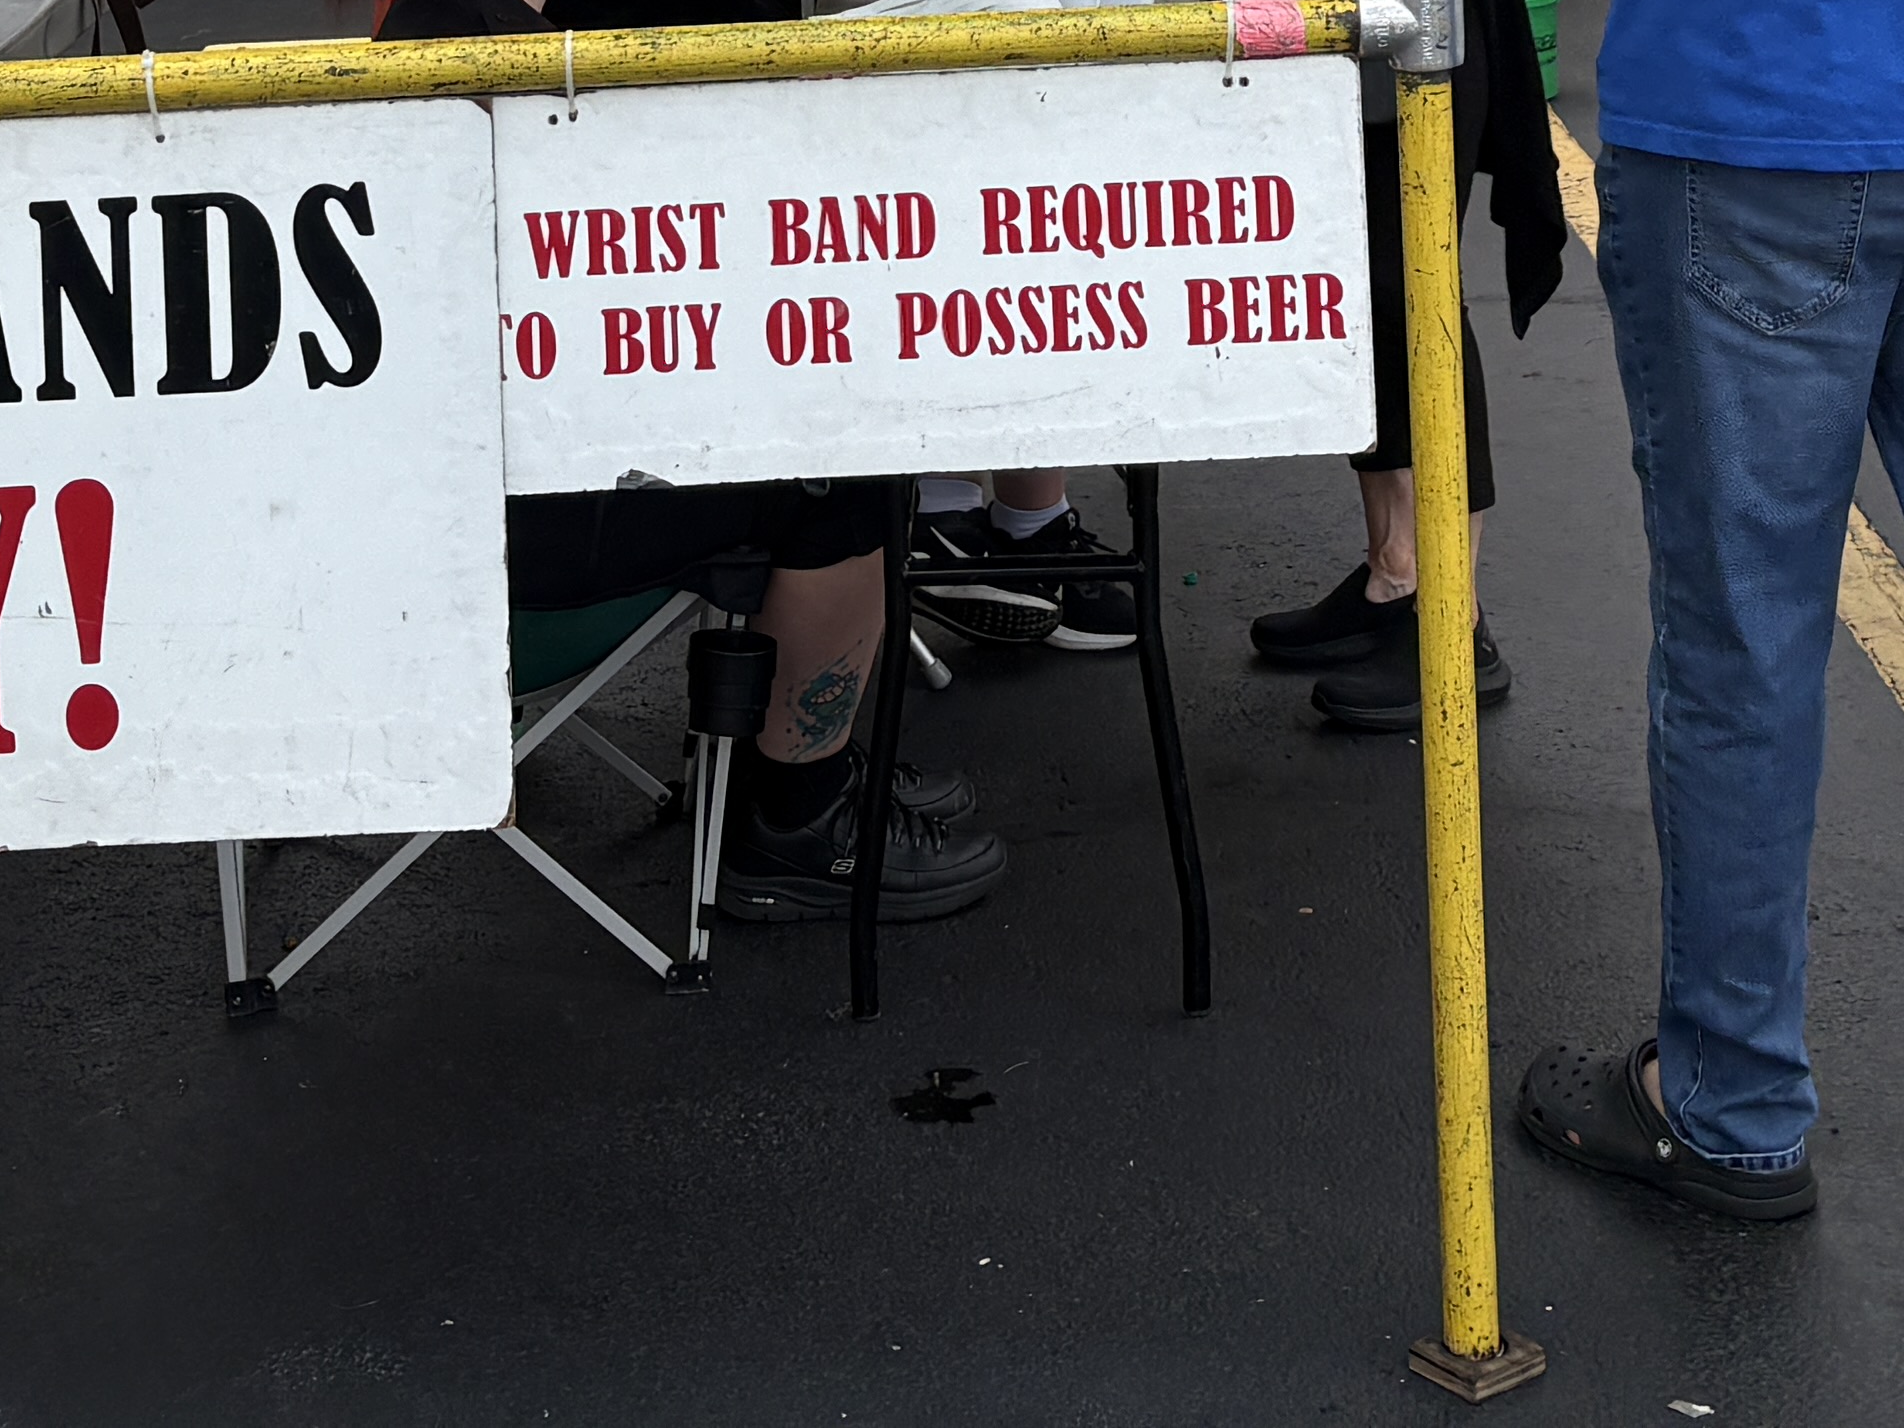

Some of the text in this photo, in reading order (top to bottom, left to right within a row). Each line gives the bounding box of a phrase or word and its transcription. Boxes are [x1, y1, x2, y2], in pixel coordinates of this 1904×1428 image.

[524, 174, 1296, 279] WRIST BAND REQUIRED
[602, 304, 721, 376] BUY
[766, 297, 853, 366] OR
[896, 282, 1149, 361] POSSESS
[1185, 273, 1348, 347] BEER
